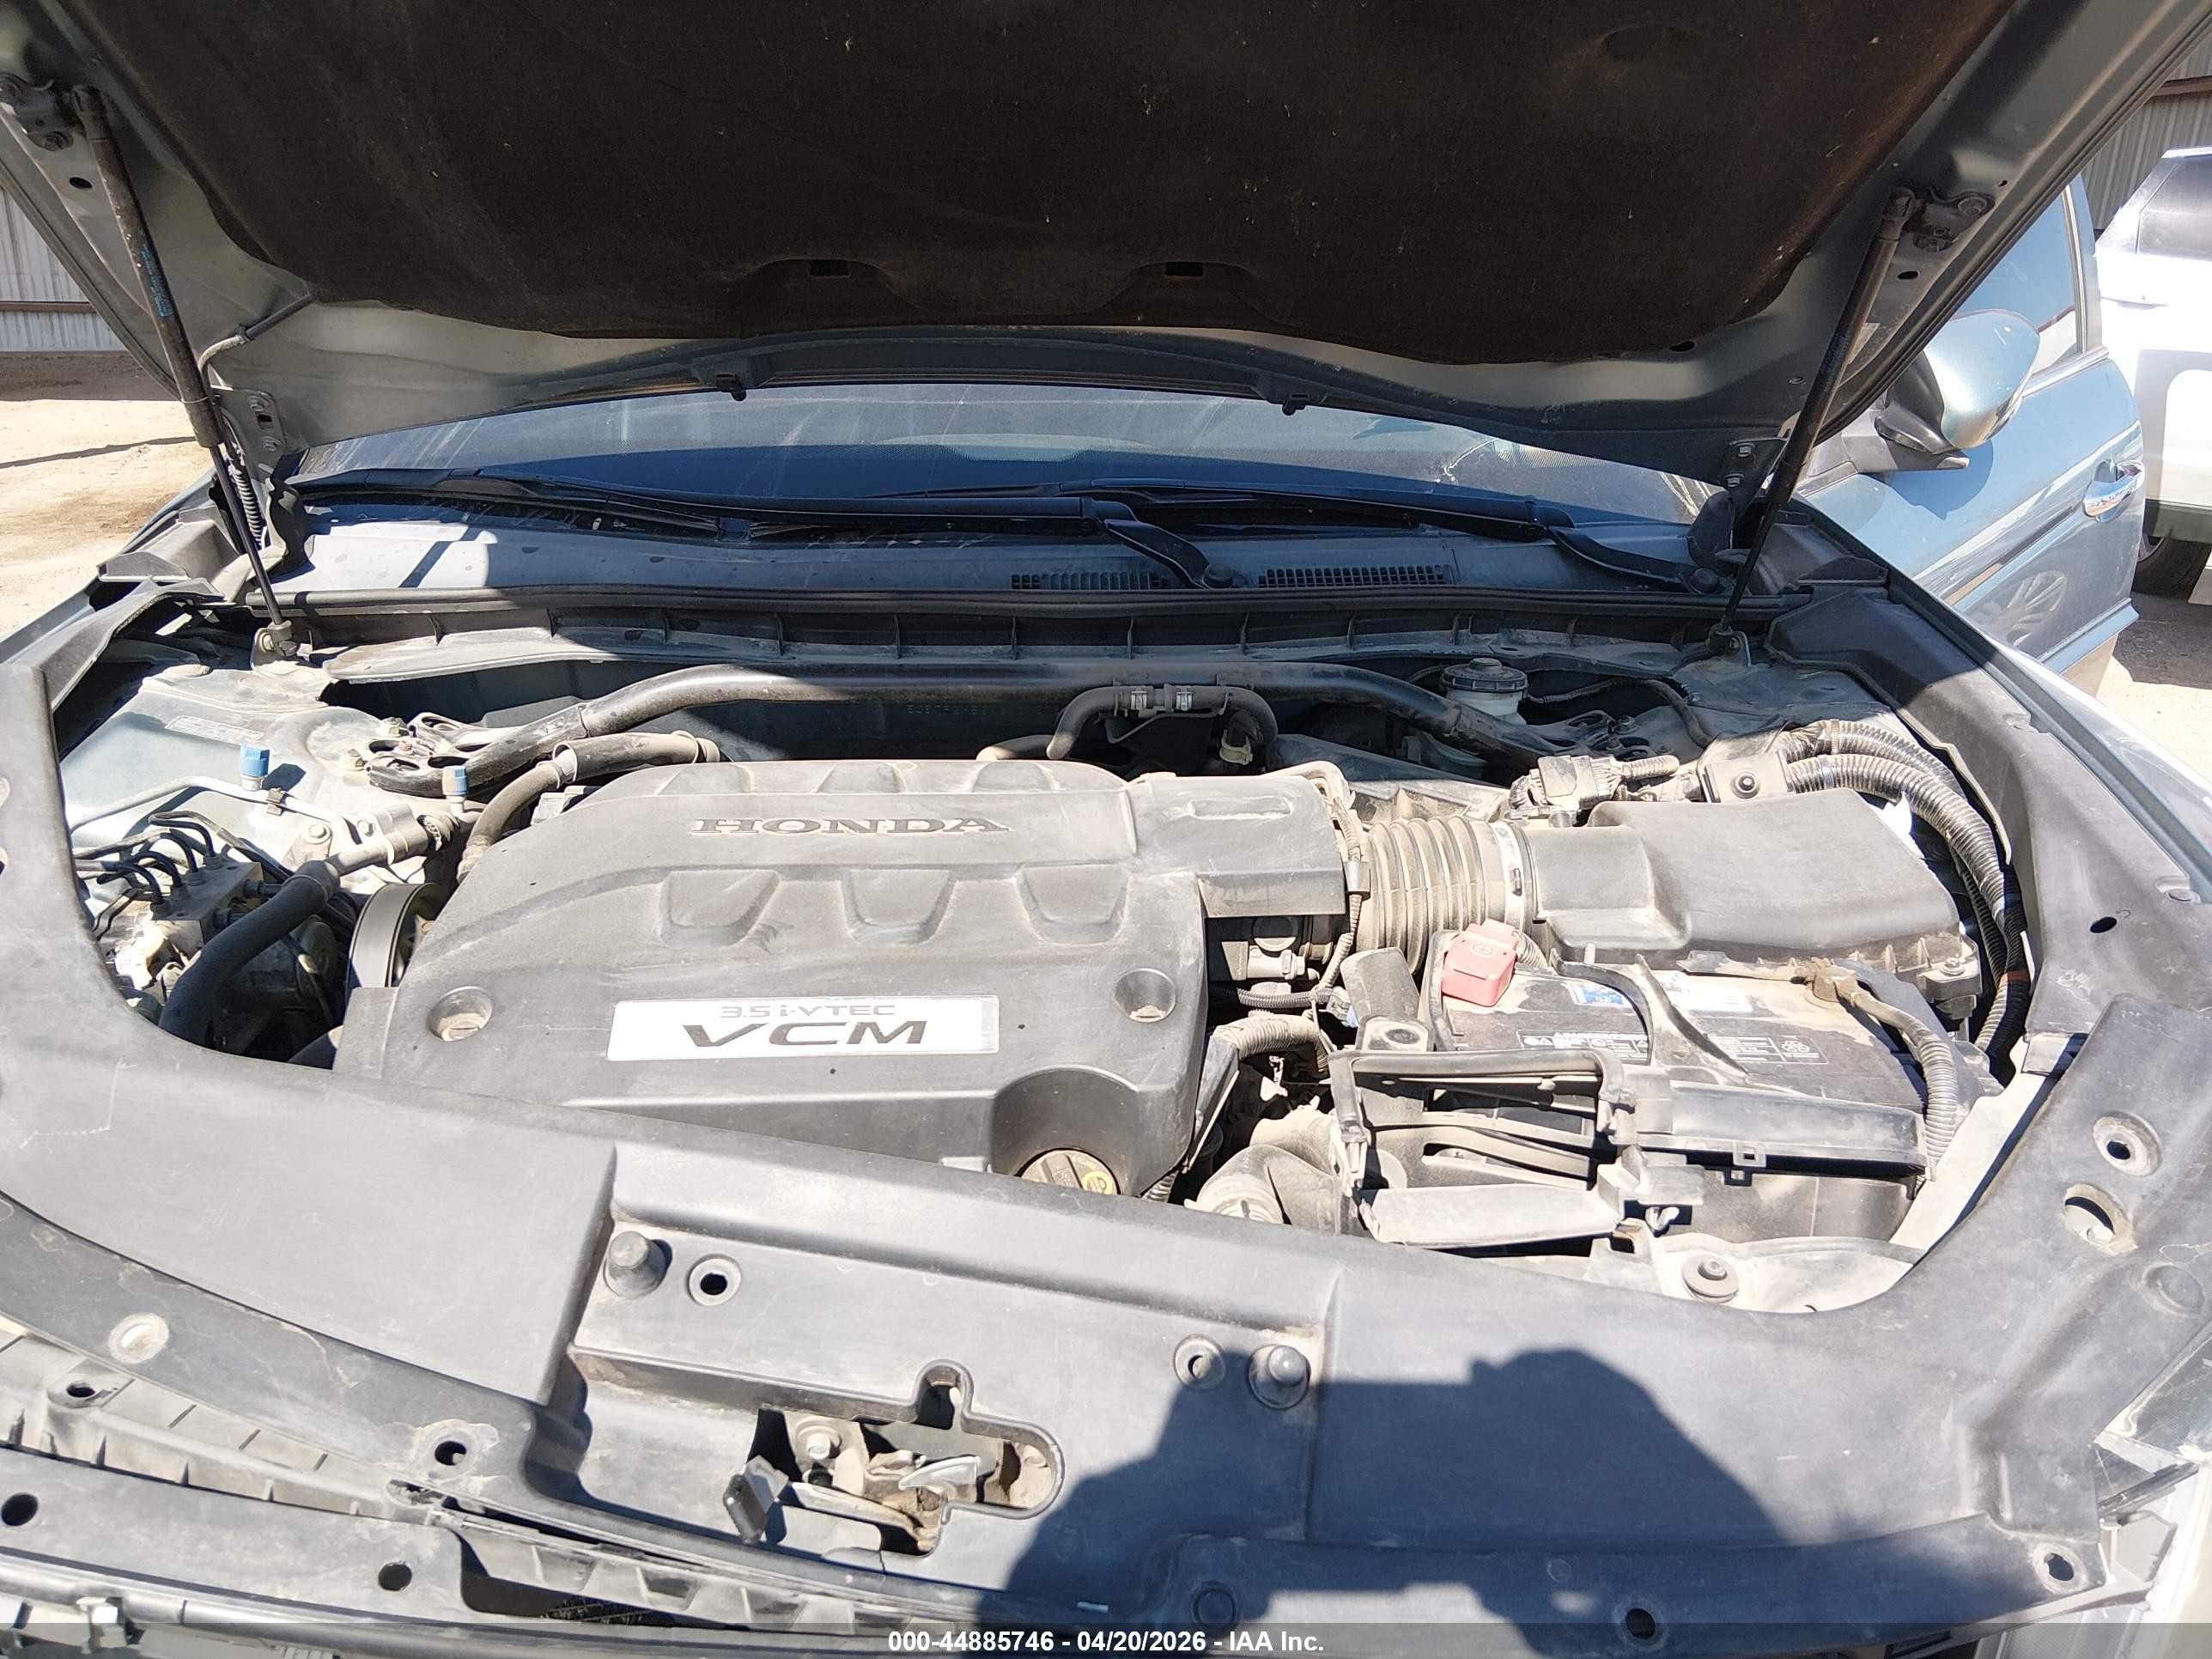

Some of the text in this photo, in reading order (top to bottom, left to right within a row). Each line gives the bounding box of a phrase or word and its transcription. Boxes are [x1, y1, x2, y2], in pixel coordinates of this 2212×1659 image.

[690, 817, 1012, 835] HONDA
[720, 1004, 896, 1018] 3.5 i-VTEC
[682, 1019, 928, 1048] VCM
